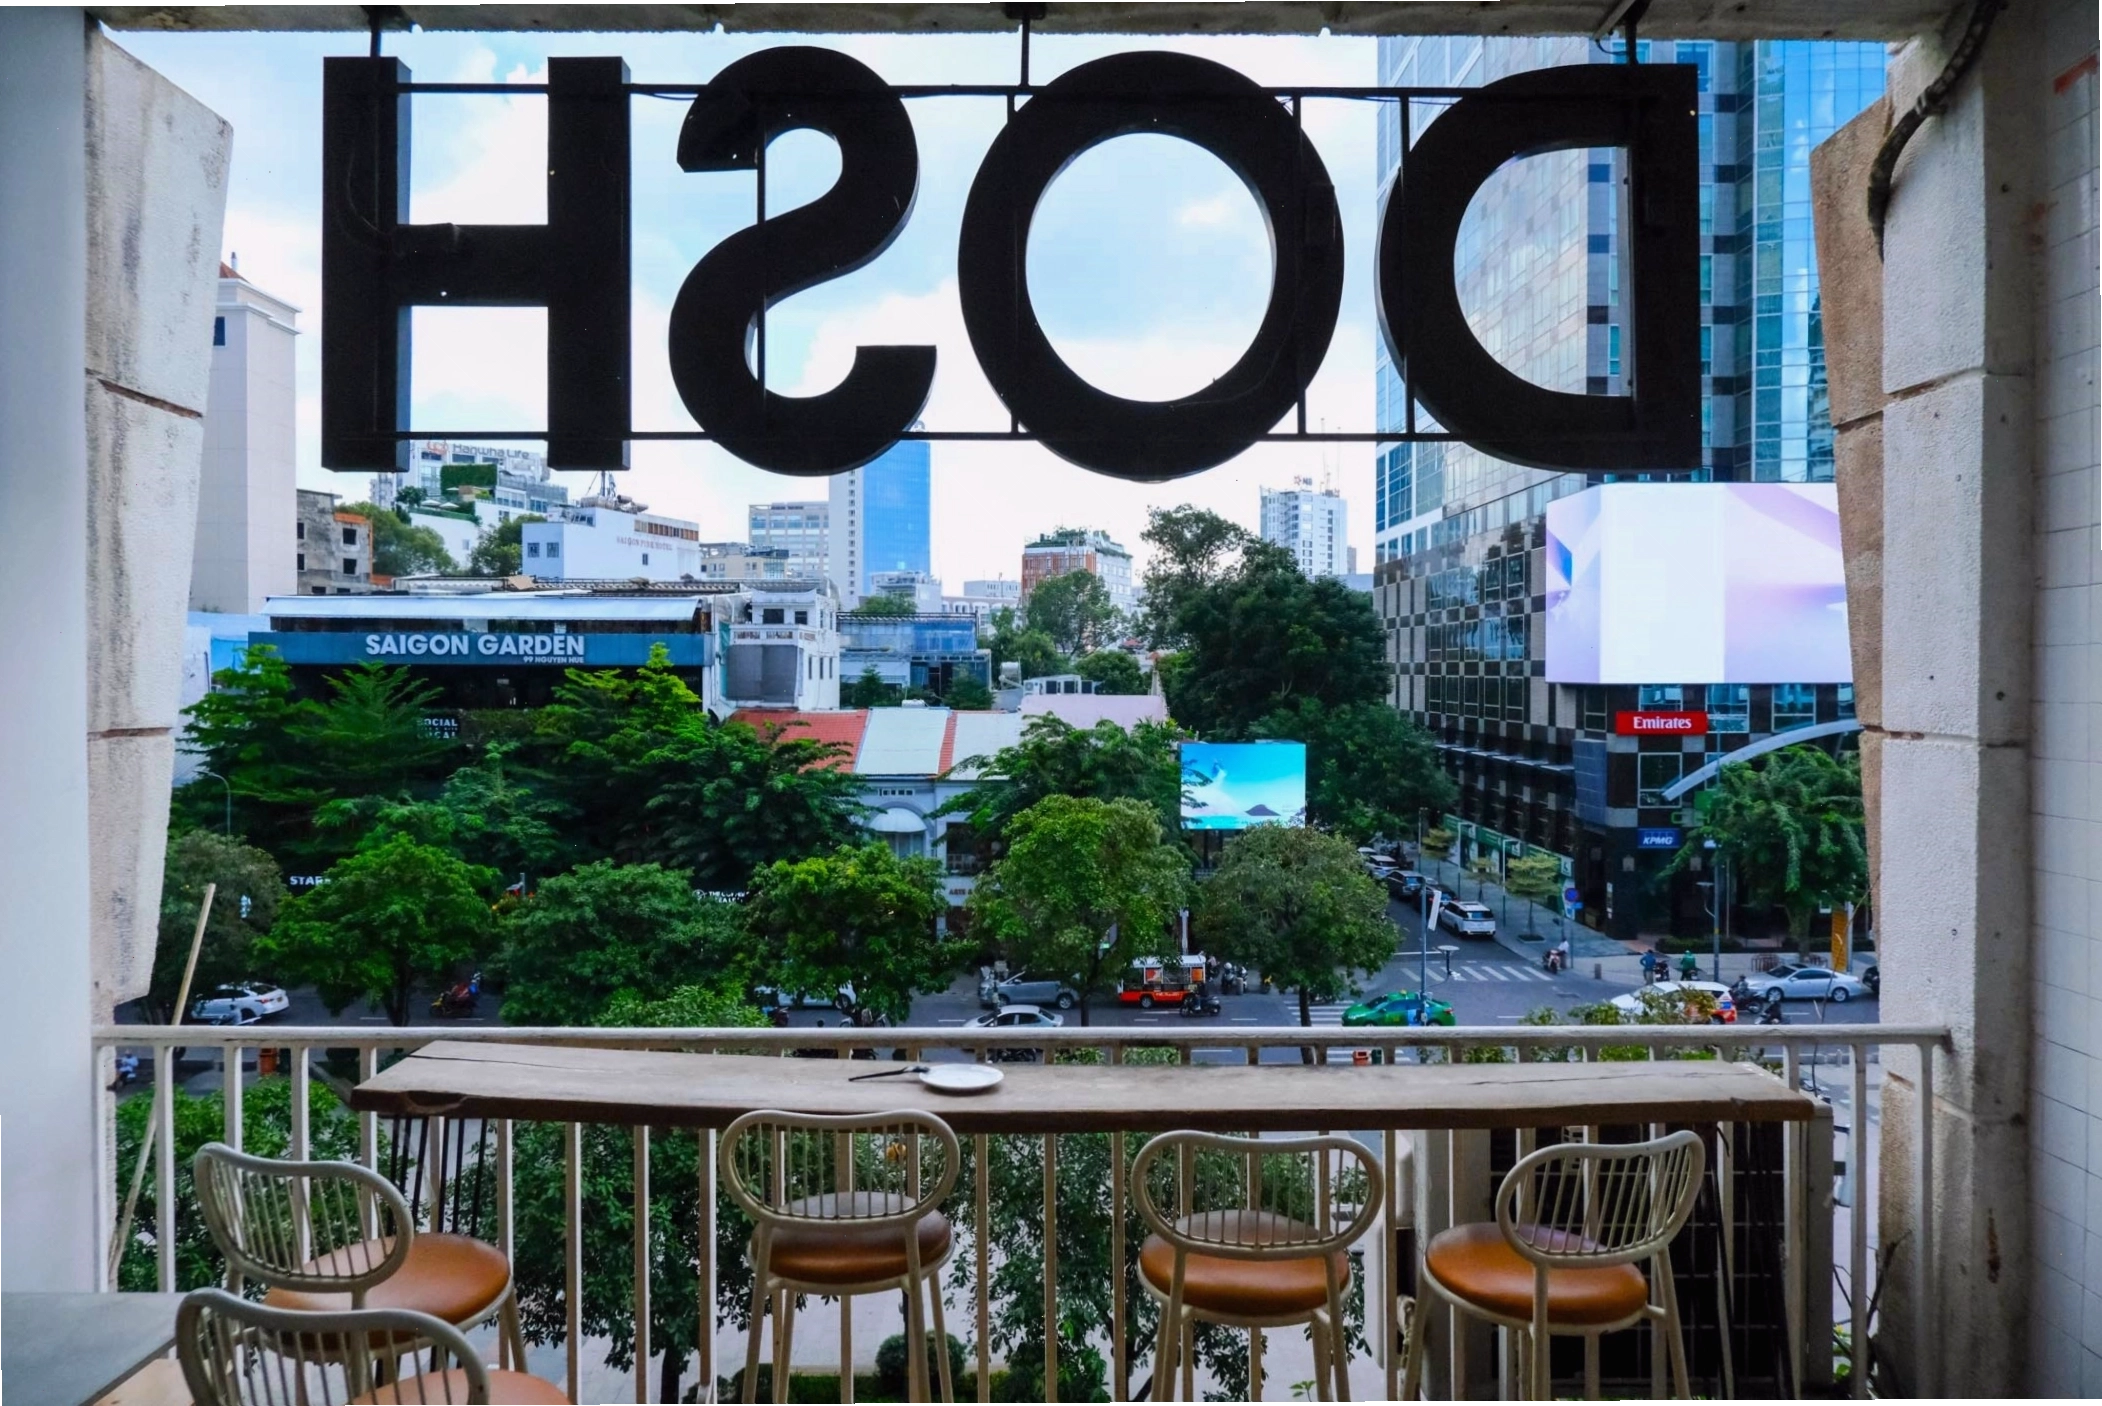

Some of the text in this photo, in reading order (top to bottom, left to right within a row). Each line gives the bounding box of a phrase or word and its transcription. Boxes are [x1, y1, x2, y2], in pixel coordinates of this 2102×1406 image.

[507, 449, 530, 459] Life
[365, 634, 585, 656] SAIGON GARDEN
[535, 656, 567, 664] NGUYEN
[568, 656, 585, 664] HUE
[1633, 716, 1692, 729] Emirates
[1642, 836, 1674, 845] KPMG
